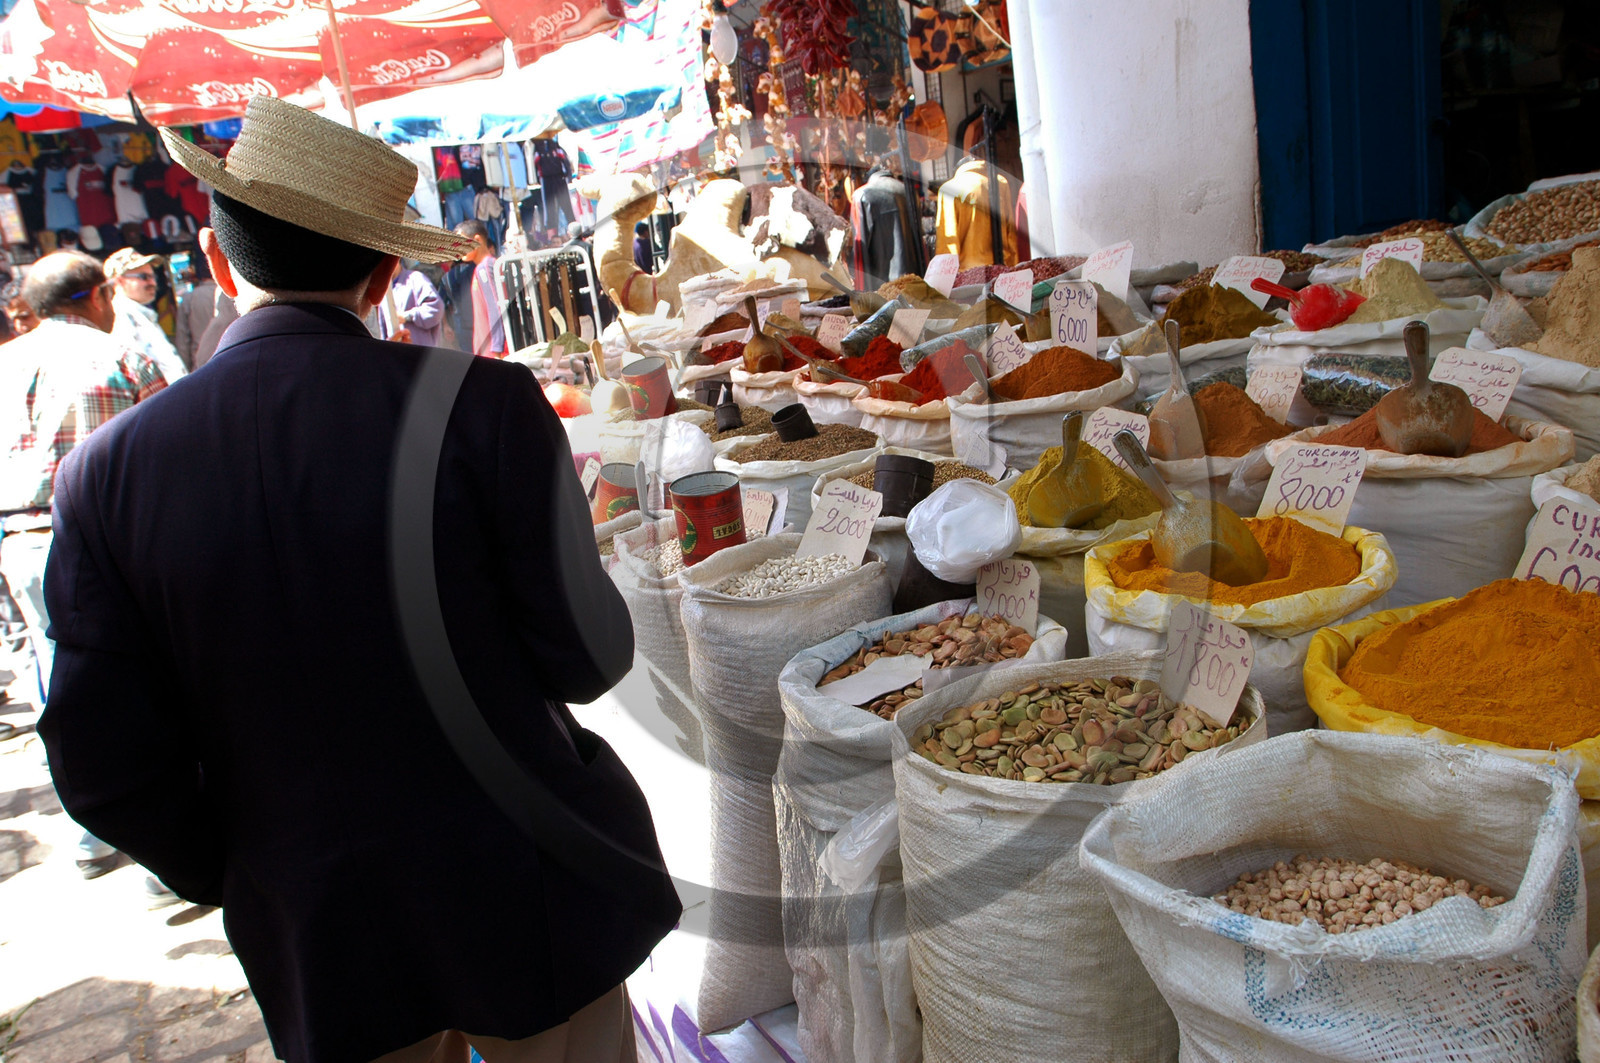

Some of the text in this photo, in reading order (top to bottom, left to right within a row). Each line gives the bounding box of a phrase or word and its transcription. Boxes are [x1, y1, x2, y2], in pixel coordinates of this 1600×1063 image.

[1058, 313, 1088, 343] 6000
[1274, 477, 1345, 515] 8000
[816, 508, 867, 538] 2000
[983, 586, 1026, 619] 2000
[1167, 633, 1236, 697] 1800
